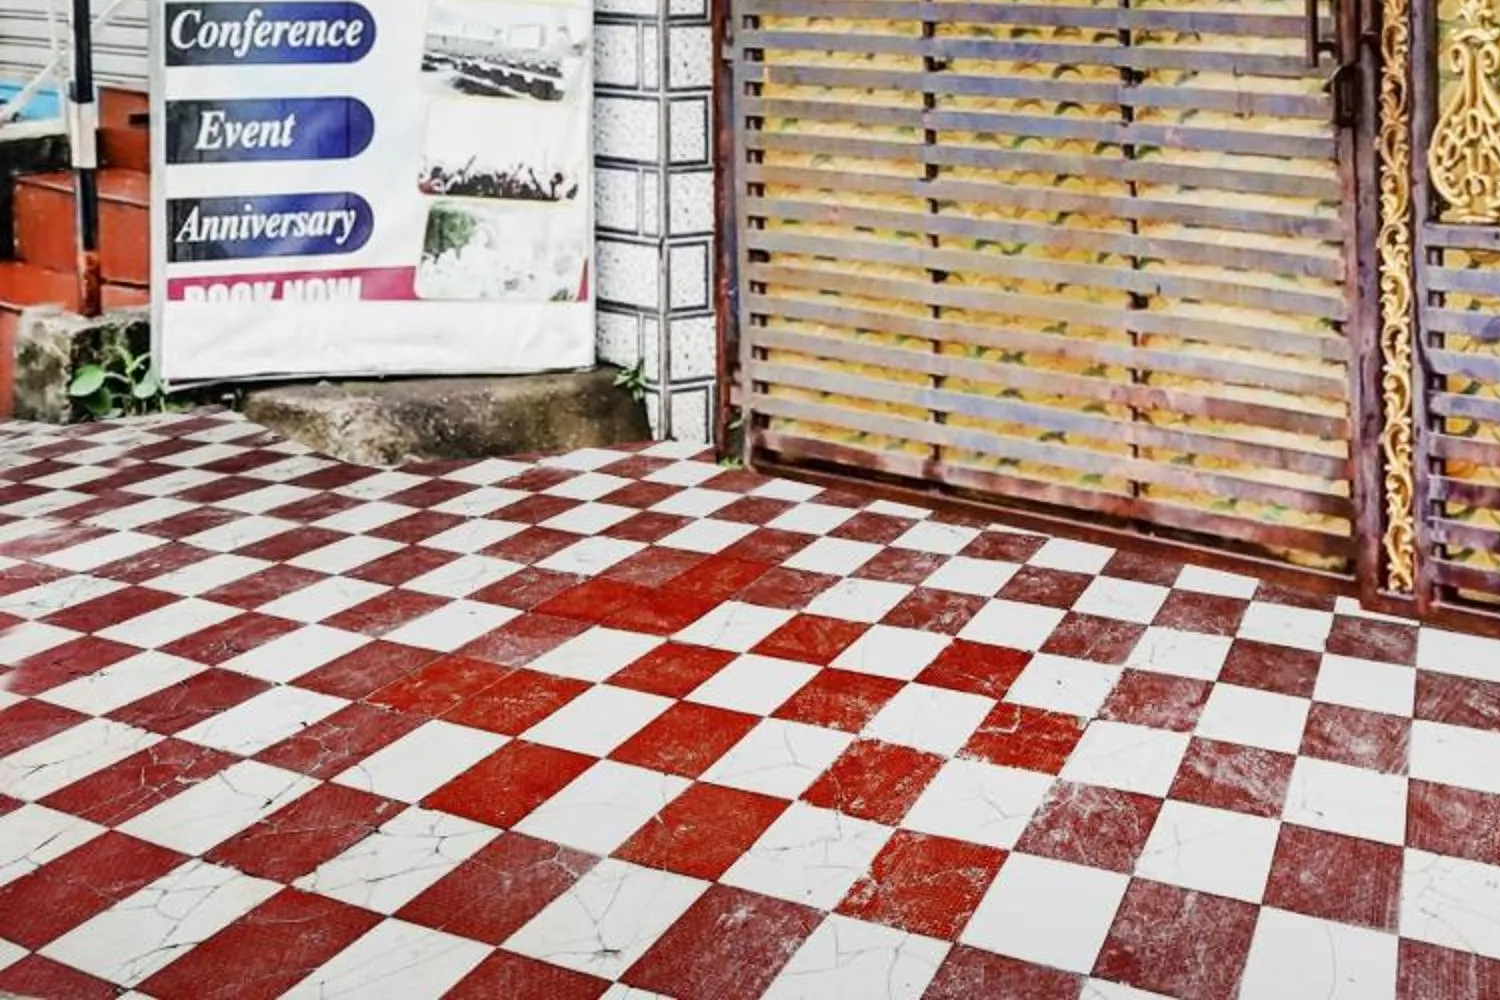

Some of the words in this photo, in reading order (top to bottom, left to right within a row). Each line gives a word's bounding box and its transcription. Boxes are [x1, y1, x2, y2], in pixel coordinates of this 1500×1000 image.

[171, 9, 364, 58] Conference
[195, 110, 297, 150] Event
[175, 204, 357, 245] Anniversary
